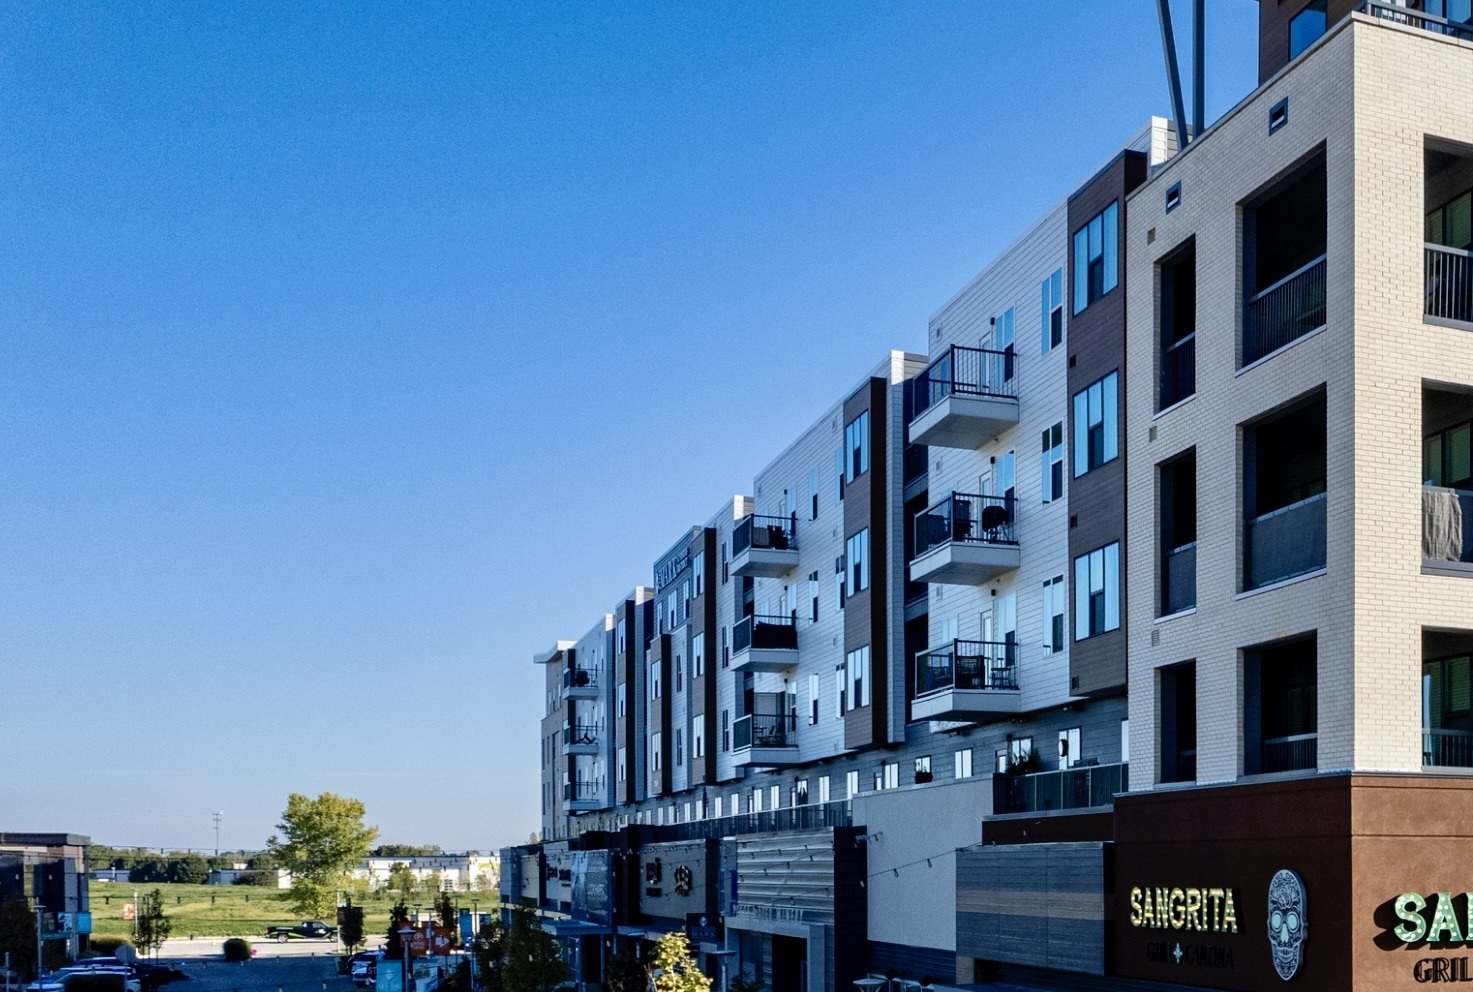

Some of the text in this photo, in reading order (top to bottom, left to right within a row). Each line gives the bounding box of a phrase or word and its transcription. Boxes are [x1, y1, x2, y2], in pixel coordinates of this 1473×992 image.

[1130, 886, 1238, 934] SANGRITA
[1146, 941, 1234, 969] GRILL CANTINA
